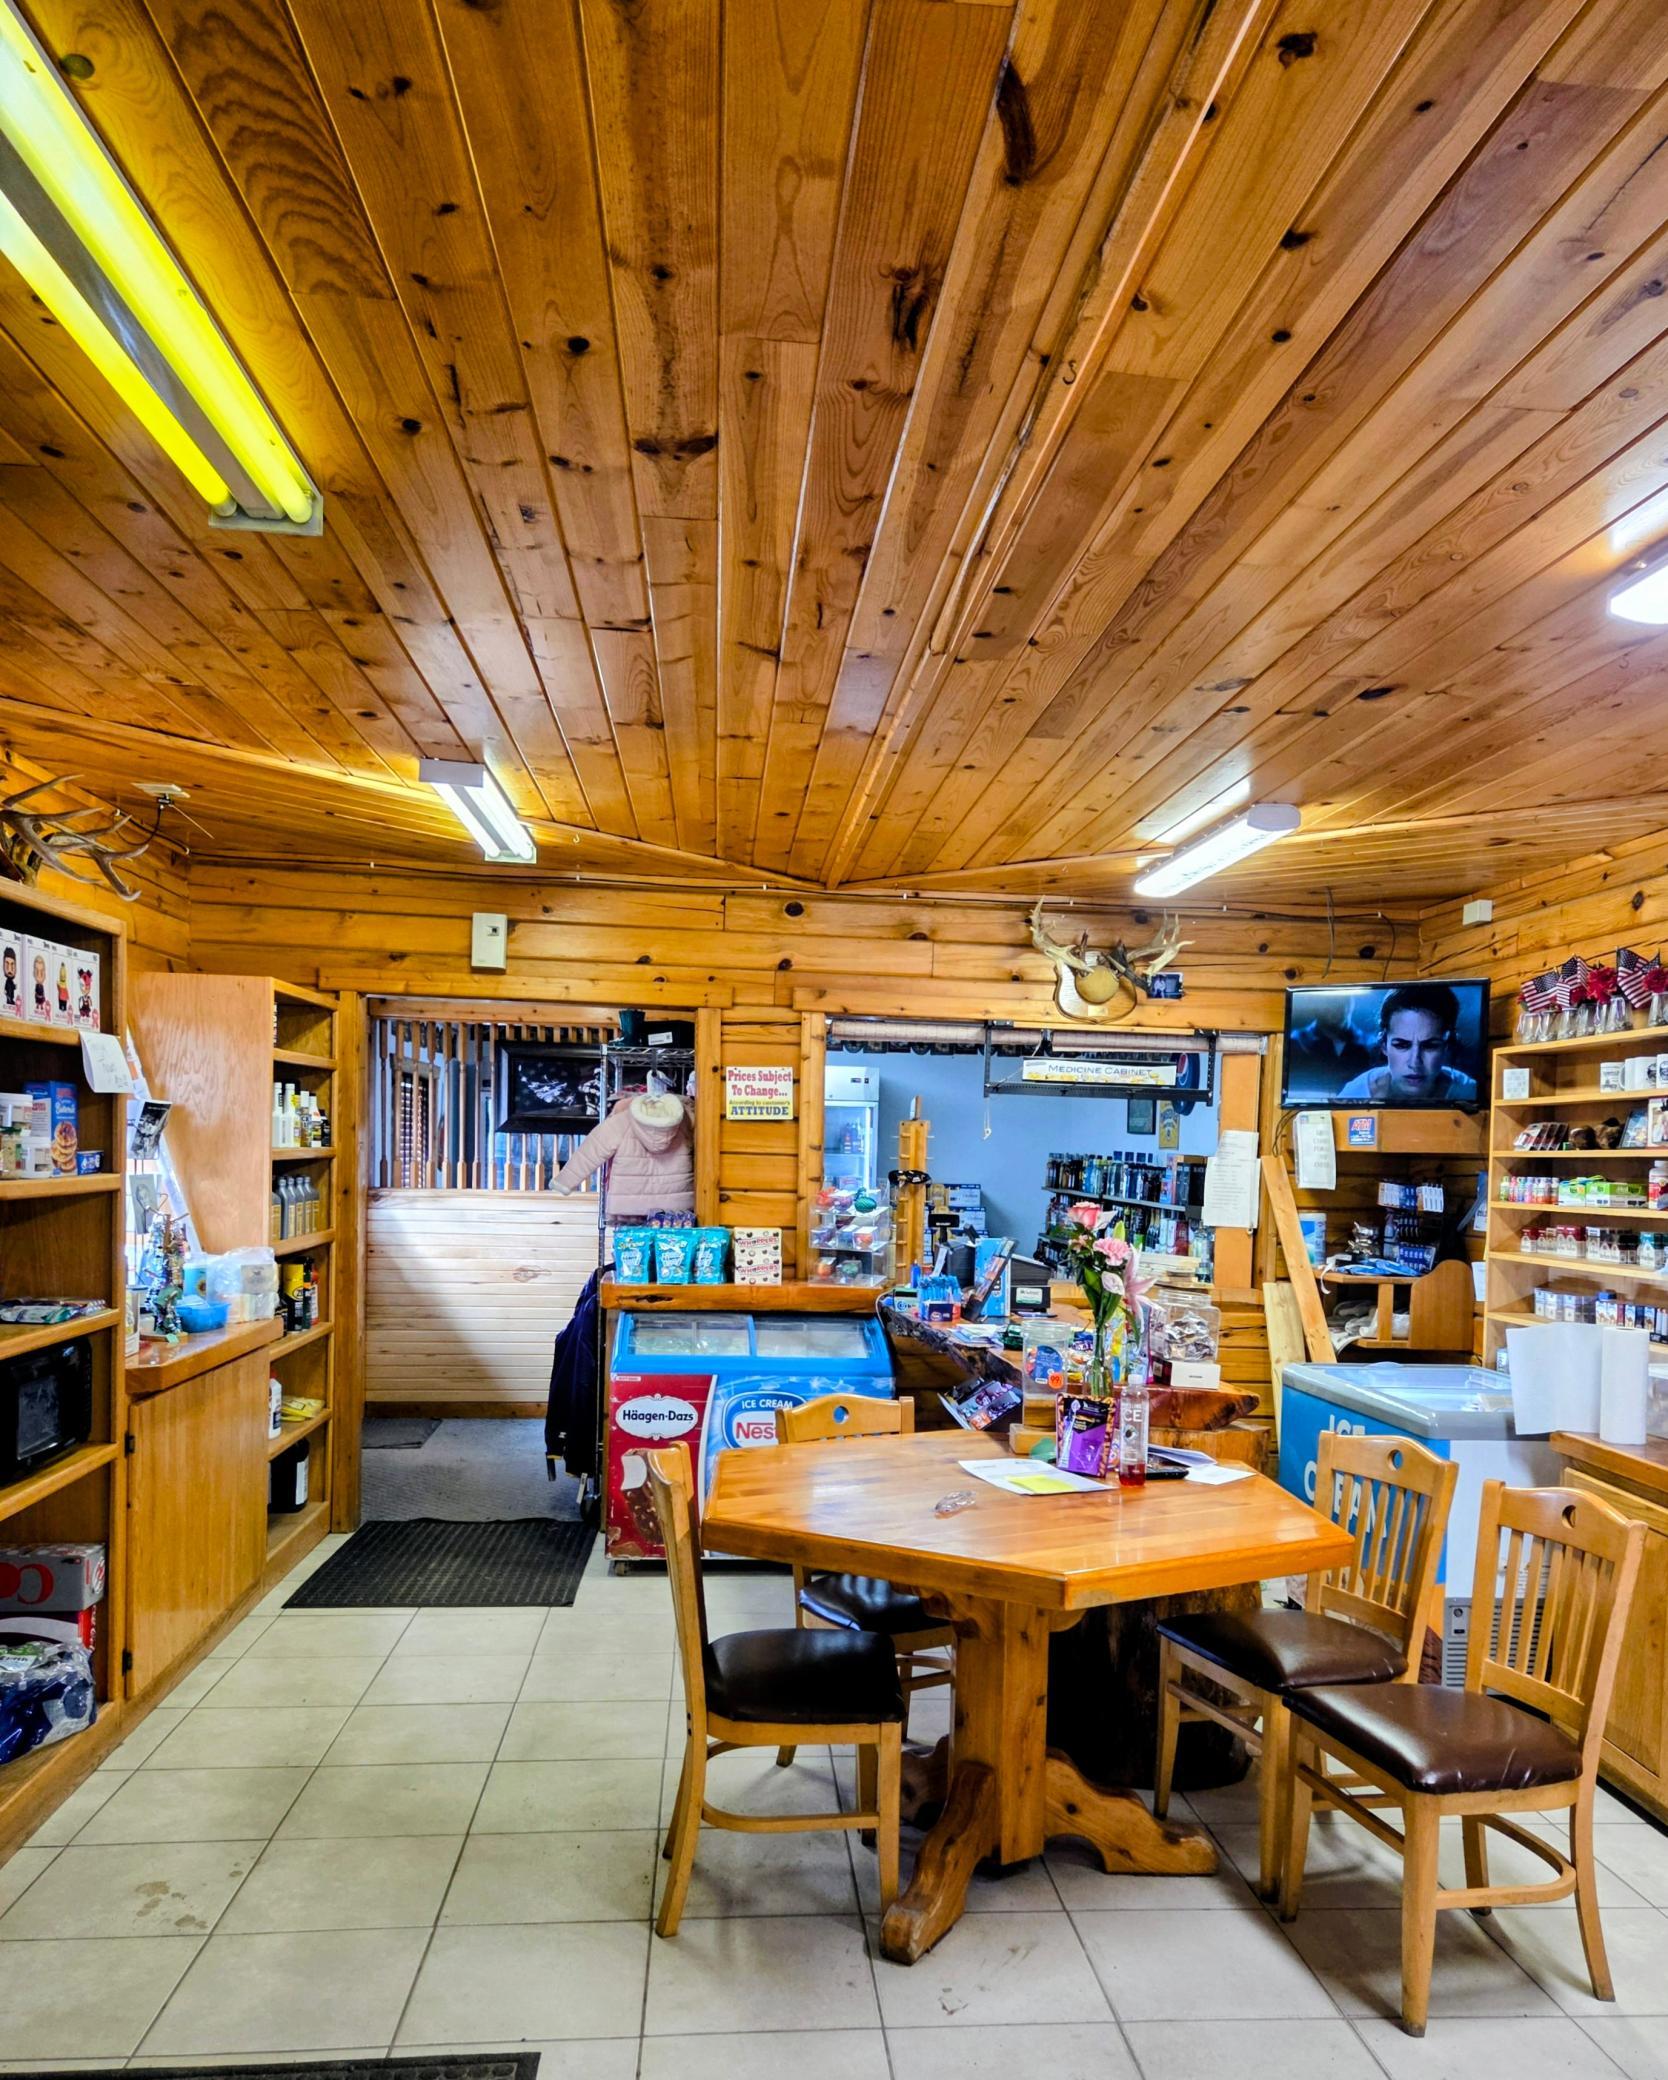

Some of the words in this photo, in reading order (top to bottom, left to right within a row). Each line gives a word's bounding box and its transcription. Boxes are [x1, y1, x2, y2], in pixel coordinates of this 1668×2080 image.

[728, 1070, 756, 1082] Prices
[758, 1070, 791, 1084] Subject
[1049, 1064, 1100, 1075] MEDICINE
[1104, 1066, 1153, 1077] CABINET
[731, 1085, 742, 1096] To
[744, 1085, 788, 1099] Change...
[731, 1106, 789, 1115] ATTITUDE
[742, 1400, 757, 1409] ICE
[759, 1399, 793, 1409] CREAM
[622, 1410, 694, 1423] Häagen-Dazs
[735, 1422, 778, 1440] Nes
